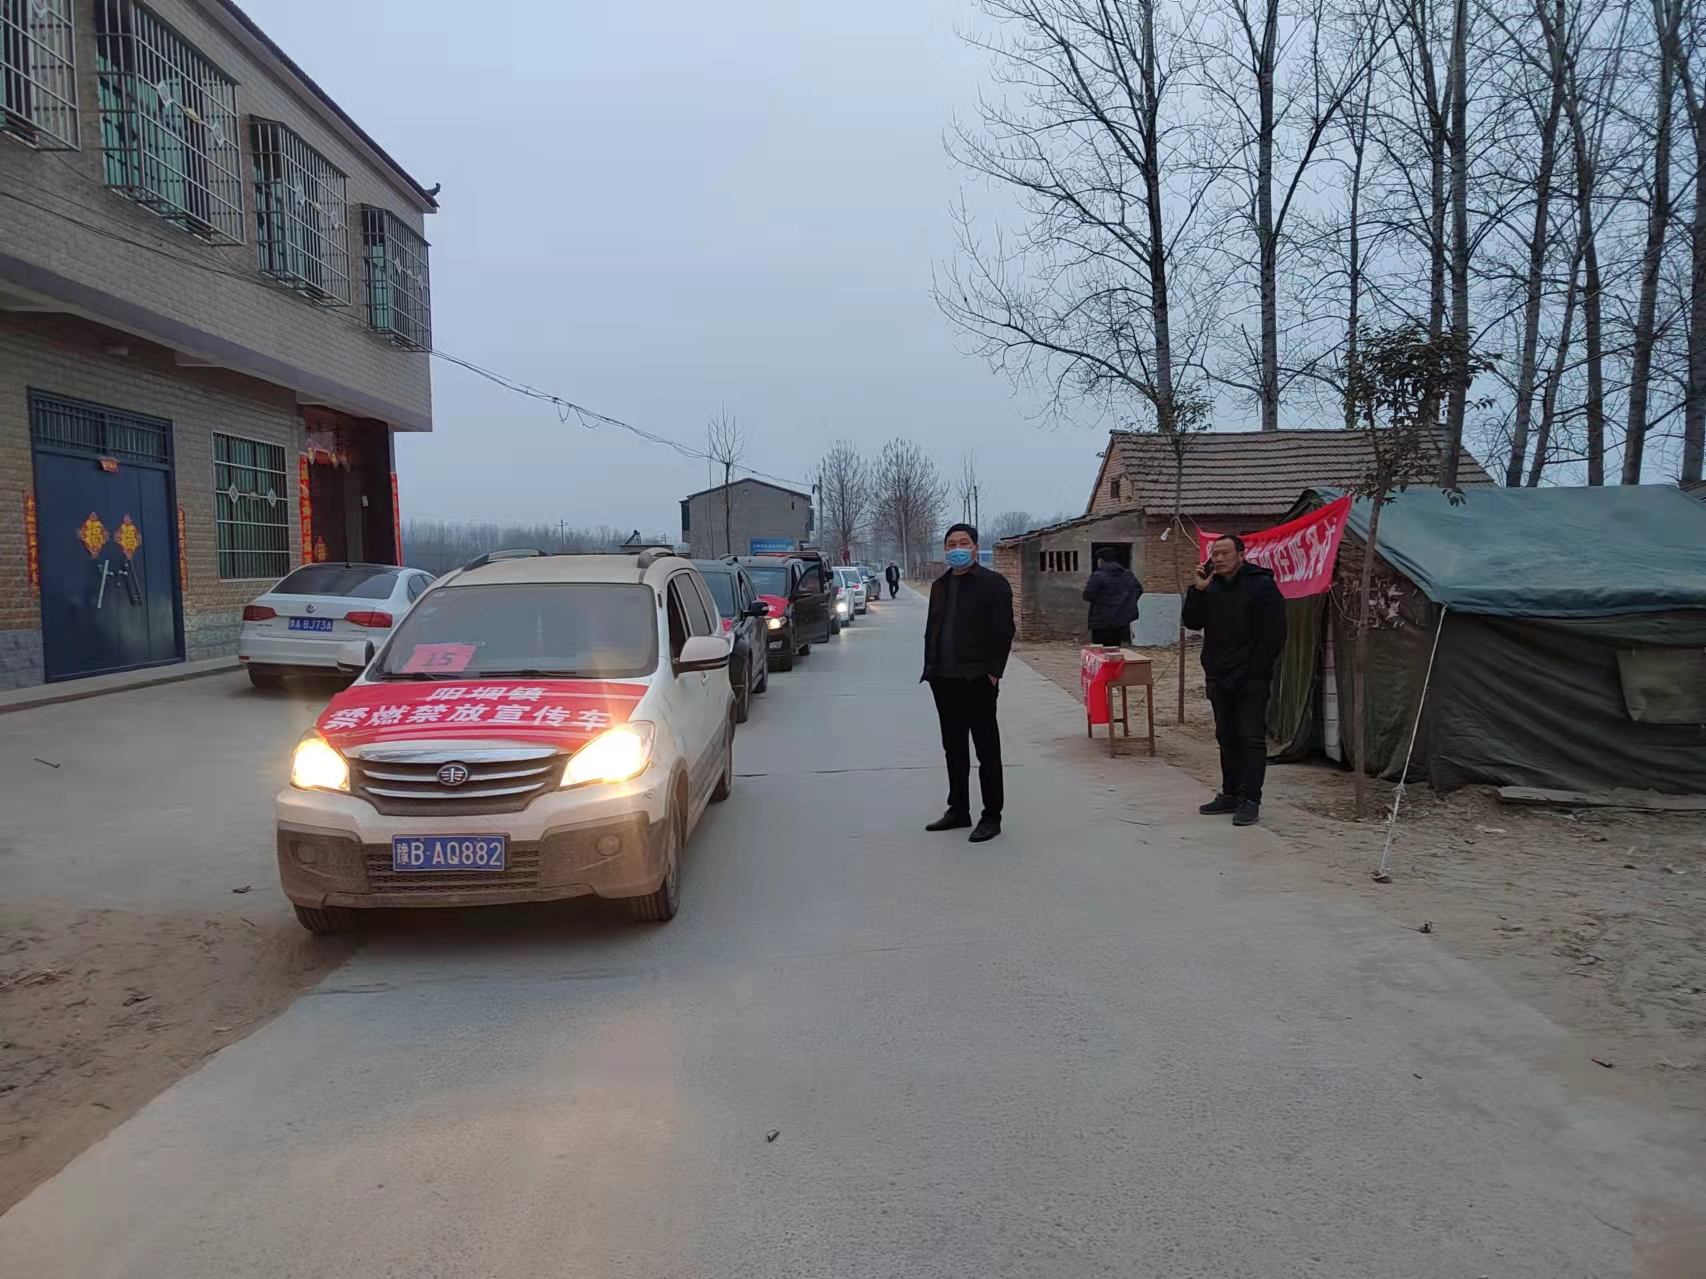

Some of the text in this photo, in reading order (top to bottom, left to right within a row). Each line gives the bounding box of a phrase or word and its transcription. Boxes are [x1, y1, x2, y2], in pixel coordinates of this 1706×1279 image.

[421, 652, 457, 667] 15
[322, 703, 611, 732] 禁燃禁放宣传车
